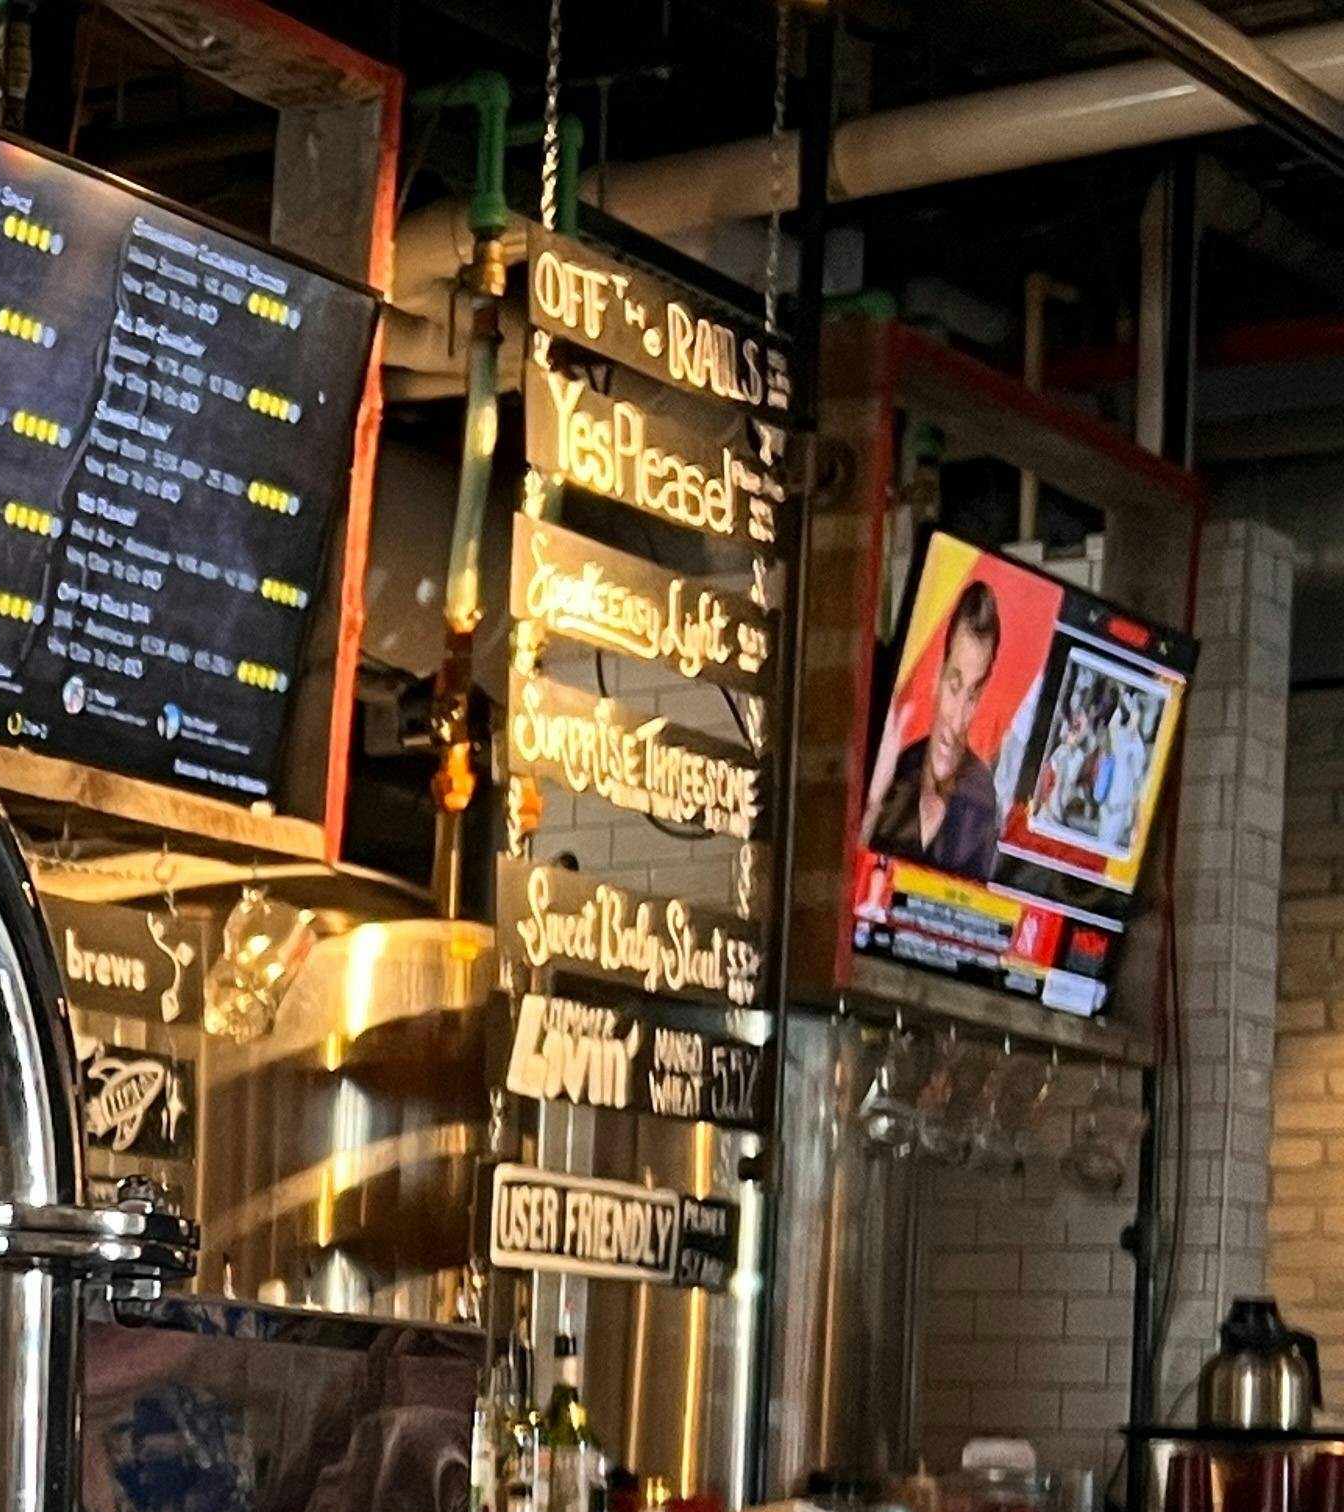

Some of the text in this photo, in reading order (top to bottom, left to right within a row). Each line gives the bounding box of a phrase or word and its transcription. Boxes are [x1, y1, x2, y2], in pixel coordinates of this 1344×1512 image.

[534, 250, 609, 340] OFF
[65, 927, 147, 992] brews
[516, 866, 596, 967] Sweet
[596, 884, 661, 993] Baby
[499, 1184, 559, 1252] USER
[563, 1189, 672, 1268] FRIENDLY
